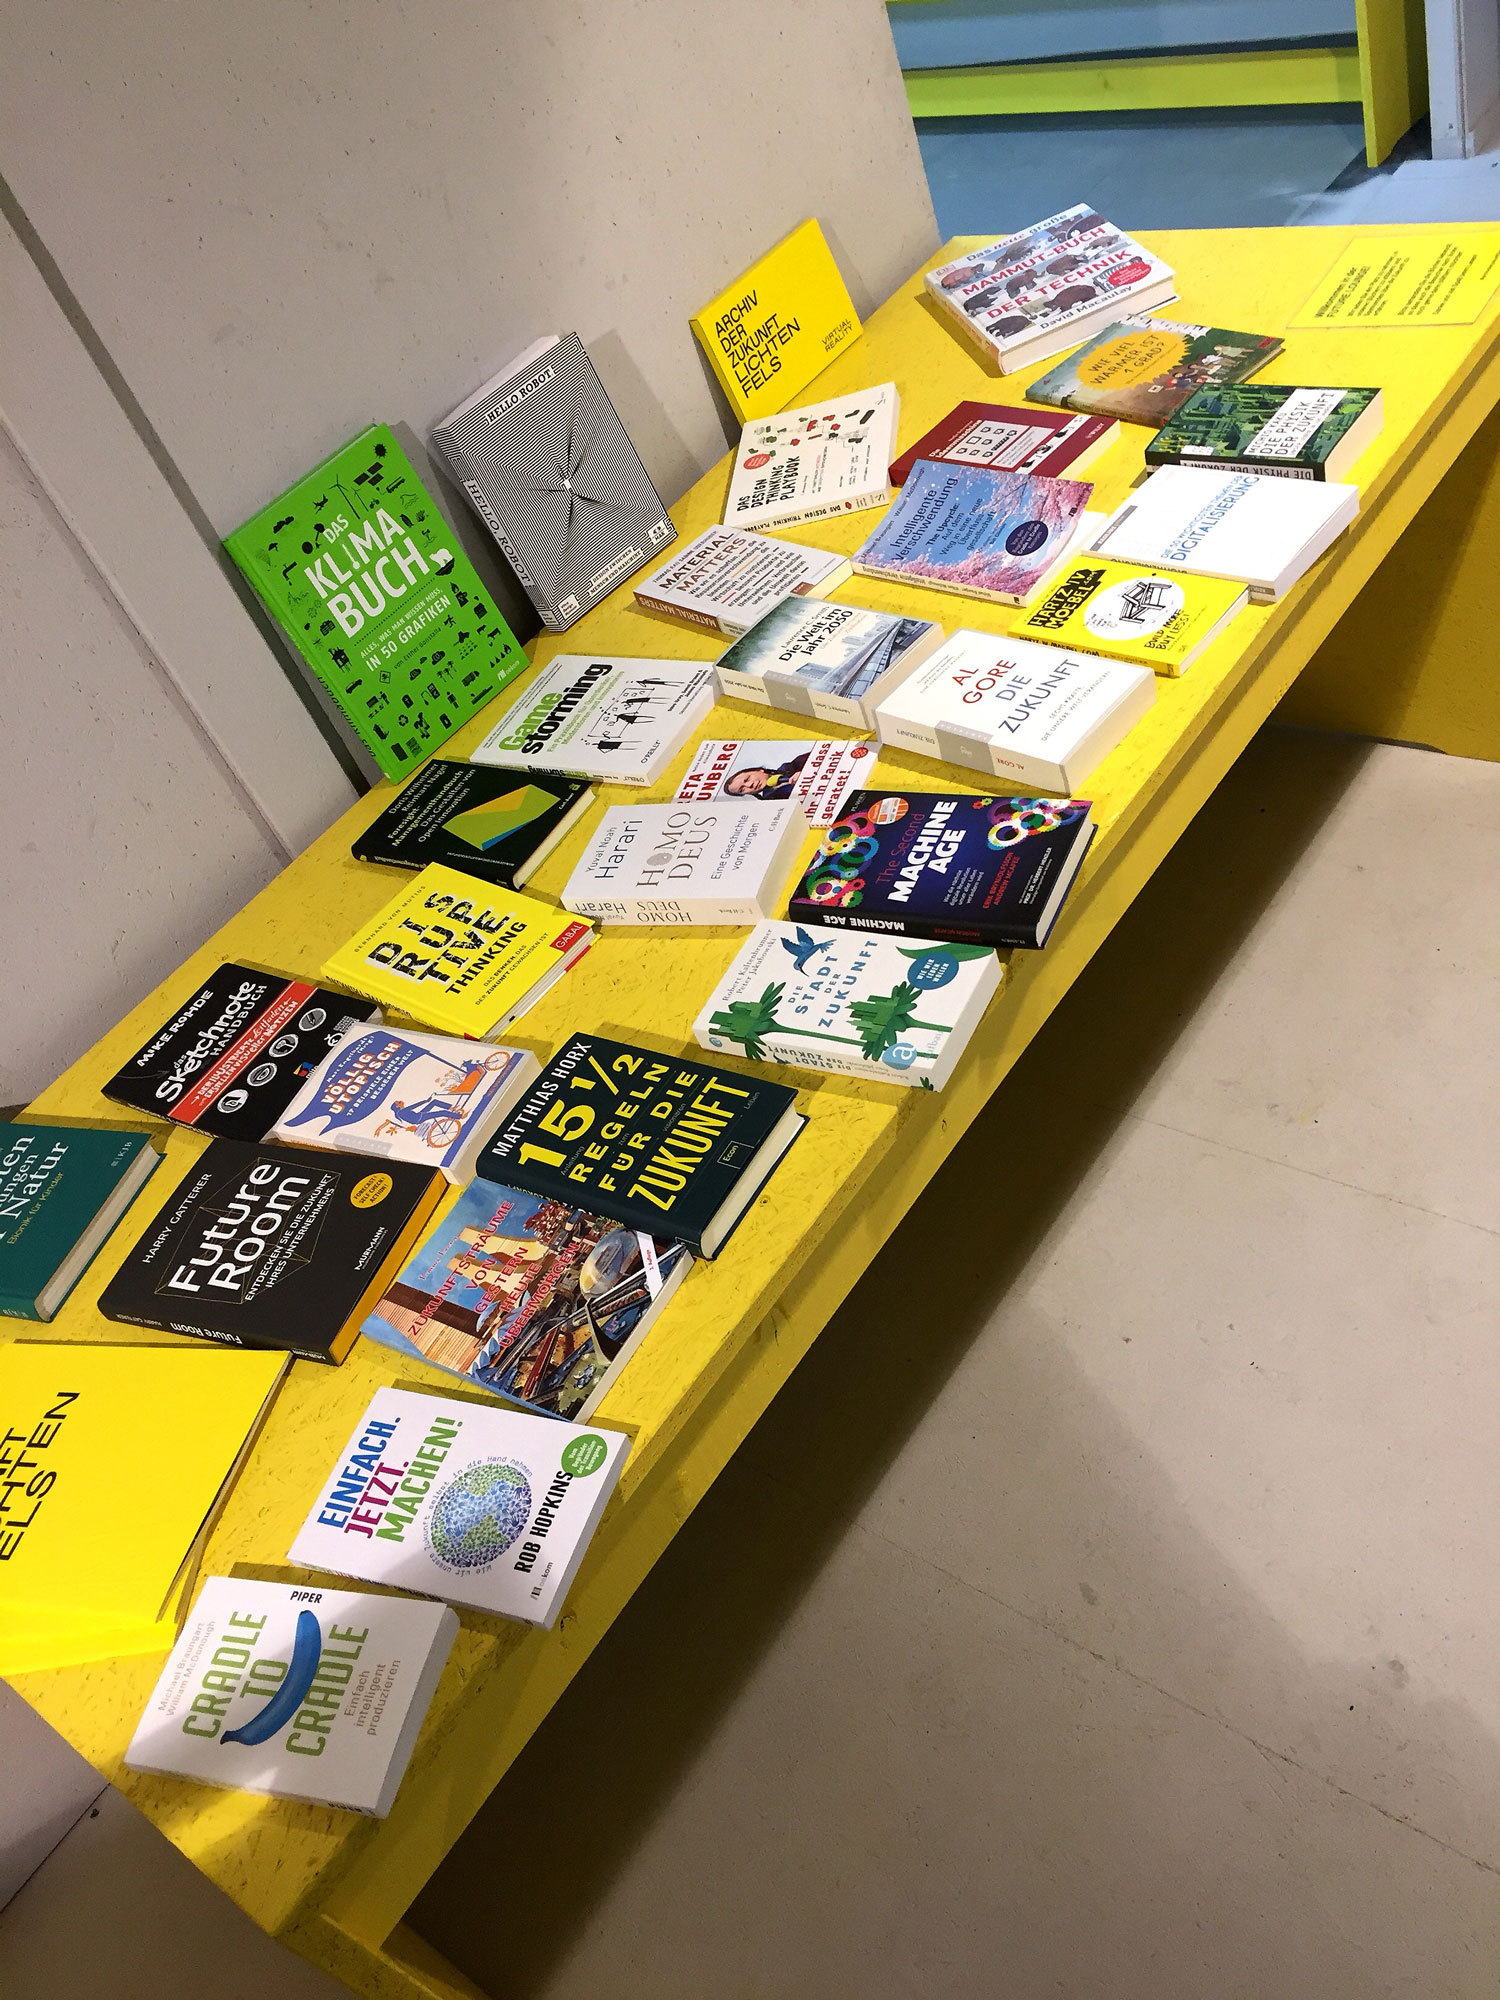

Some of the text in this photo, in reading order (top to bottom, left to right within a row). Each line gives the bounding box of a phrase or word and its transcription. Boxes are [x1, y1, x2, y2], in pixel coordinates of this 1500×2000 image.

[962, 227, 1106, 296] MAMMUT-BUCH
[986, 296, 1031, 319] DER
[1038, 250, 1132, 295] TECHNIK
[714, 290, 758, 338] ARCHIV
[821, 319, 851, 345] VIRTUAL
[1040, 285, 1133, 329] David Macaulay
[720, 324, 747, 353] DER
[727, 313, 780, 369] ZUKUNFT
[735, 318, 800, 384] LICHTEN
[825, 325, 853, 352] REALITY
[1088, 342, 1135, 371] WIE VIEL
[1134, 342, 1164, 366] GRAD?
[1140, 335, 1159, 347] IST
[741, 356, 782, 398] FELS
[1259, 401, 1312, 454] DIE PHYSIK
[1275, 435, 1299, 455] DER
[1298, 392, 1336, 433] ZUKUNFT
[737, 495, 750, 511] DAS
[751, 479, 767, 508] DESIGN
[765, 465, 784, 505] THINKING
[780, 456, 800, 500] PLAYBOOK
[322, 514, 350, 544] DAS
[890, 490, 937, 547] Intelligente
[891, 477, 958, 560] Verschwendung
[1170, 476, 1261, 561] DIGITALISIERUNG
[326, 538, 430, 638] BUCH
[658, 533, 735, 589] MATERIAL
[676, 537, 747, 593] MATTERS
[1029, 571, 1086, 626] HARTZ IV
[1049, 584, 1095, 629] MOEBEL
[360, 642, 379, 658] ALLES,
[378, 629, 392, 642] WAS
[391, 618, 405, 631] MAN
[404, 600, 426, 620] WISSEN
[366, 595, 451, 671] IN 50 GRAFIKEN
[779, 608, 843, 662] Die Welt im
[800, 610, 853, 657] Jahr 2050
[1144, 608, 1184, 649] BUILD MORE
[1156, 613, 1191, 650] BUY LESS!
[951, 668, 979, 686] AL
[962, 659, 1017, 704] GORE
[995, 674, 1033, 702] DIE
[998, 659, 1080, 734] ZUKUNFT
[499, 692, 564, 751] Game
[521, 664, 613, 755] Storming
[798, 743, 831, 796] will, dass
[804, 751, 844, 818] Ihr in Panik
[822, 771, 851, 819] geratet!
[388, 805, 420, 838] Foresight-
[392, 770, 464, 846] Managementhandbuch
[418, 788, 470, 842] Open Innovation
[584, 826, 617, 873] Yuval Noah
[593, 820, 643, 880] Harari
[635, 811, 692, 888] HOMO
[667, 816, 718, 880] DEUS
[710, 814, 749, 880] Eine Geschichte
[732, 822, 760, 871] von Morgen
[886, 800, 958, 903] MACHINE
[926, 828, 966, 876] AGE
[554, 923, 585, 950] GABAL
[637, 912, 692, 922] HOMO
[823, 914, 905, 931] MACHINE AGE
[445, 921, 528, 994] THINKING
[794, 955, 838, 1015] STADT
[818, 940, 878, 1027] ZUKUNFT
[824, 973, 842, 993] DER
[916, 959, 934, 979] WIE WIR
[926, 963, 940, 979] LEBEN
[932, 963, 949, 982] WOLLEN
[210, 985, 268, 1056] HANDBUCH
[787, 985, 804, 1003] DIE
[136, 989, 214, 1067] MIKE ROHDE
[155, 981, 257, 1103] Sketchnote
[321, 1053, 376, 1104] VÖLLIG
[329, 1041, 403, 1114] UTOPISCH
[491, 1080, 560, 1157] MATTHIAS
[551, 1041, 592, 1079] HORX
[568, 1062, 671, 1183] REGELN
[598, 1070, 699, 1193] FÜR DIE
[628, 1076, 751, 1212] ZUKUNFT
[0, 1142, 69, 1220] Natur
[721, 1144, 739, 1163] Econ
[353, 1175, 378, 1199] FORECAST!
[369, 1184, 388, 1203] ACTION!
[141, 1172, 213, 1265] HARRY GATTERER
[167, 1164, 281, 1293] Future
[207, 1176, 311, 1291] Room
[245, 1173, 332, 1300] ENTDECKEN SIE DIE ZUKUNFT
[265, 1187, 335, 1288] IHRES UNTERNEHMENS
[407, 1199, 515, 1337] ZUKUNFTSTRÄUME
[465, 1258, 497, 1290] VON
[474, 1246, 530, 1315] GESTERN
[498, 1241, 581, 1349] ÜBERMORGEN
[500, 1262, 543, 1312] HEUTE
[317, 1416, 401, 1528] EINFACH.
[375, 1417, 463, 1544] MACHEN!
[453, 1469, 463, 1478] in
[467, 1459, 482, 1470] die
[510, 1458, 533, 1477] nehmen
[344, 1460, 410, 1539] JETZT.
[429, 1481, 449, 1510] selbst
[513, 1471, 574, 1574] ROB HOPKINS
[423, 1516, 431, 1552] Zukunft
[429, 1553, 452, 1573] unsere
[289, 1590, 323, 1605] PIPER
[157, 1622, 205, 1711] Michael Braungart
[166, 1620, 216, 1717] William McDonough
[182, 1611, 268, 1739] CRADLE
[239, 1658, 288, 1699] TO
[285, 1624, 369, 1757] CRADLE
[343, 1669, 369, 1718] Einfach
[355, 1663, 386, 1728] intelligent
[367, 1659, 400, 1735] produzieren
